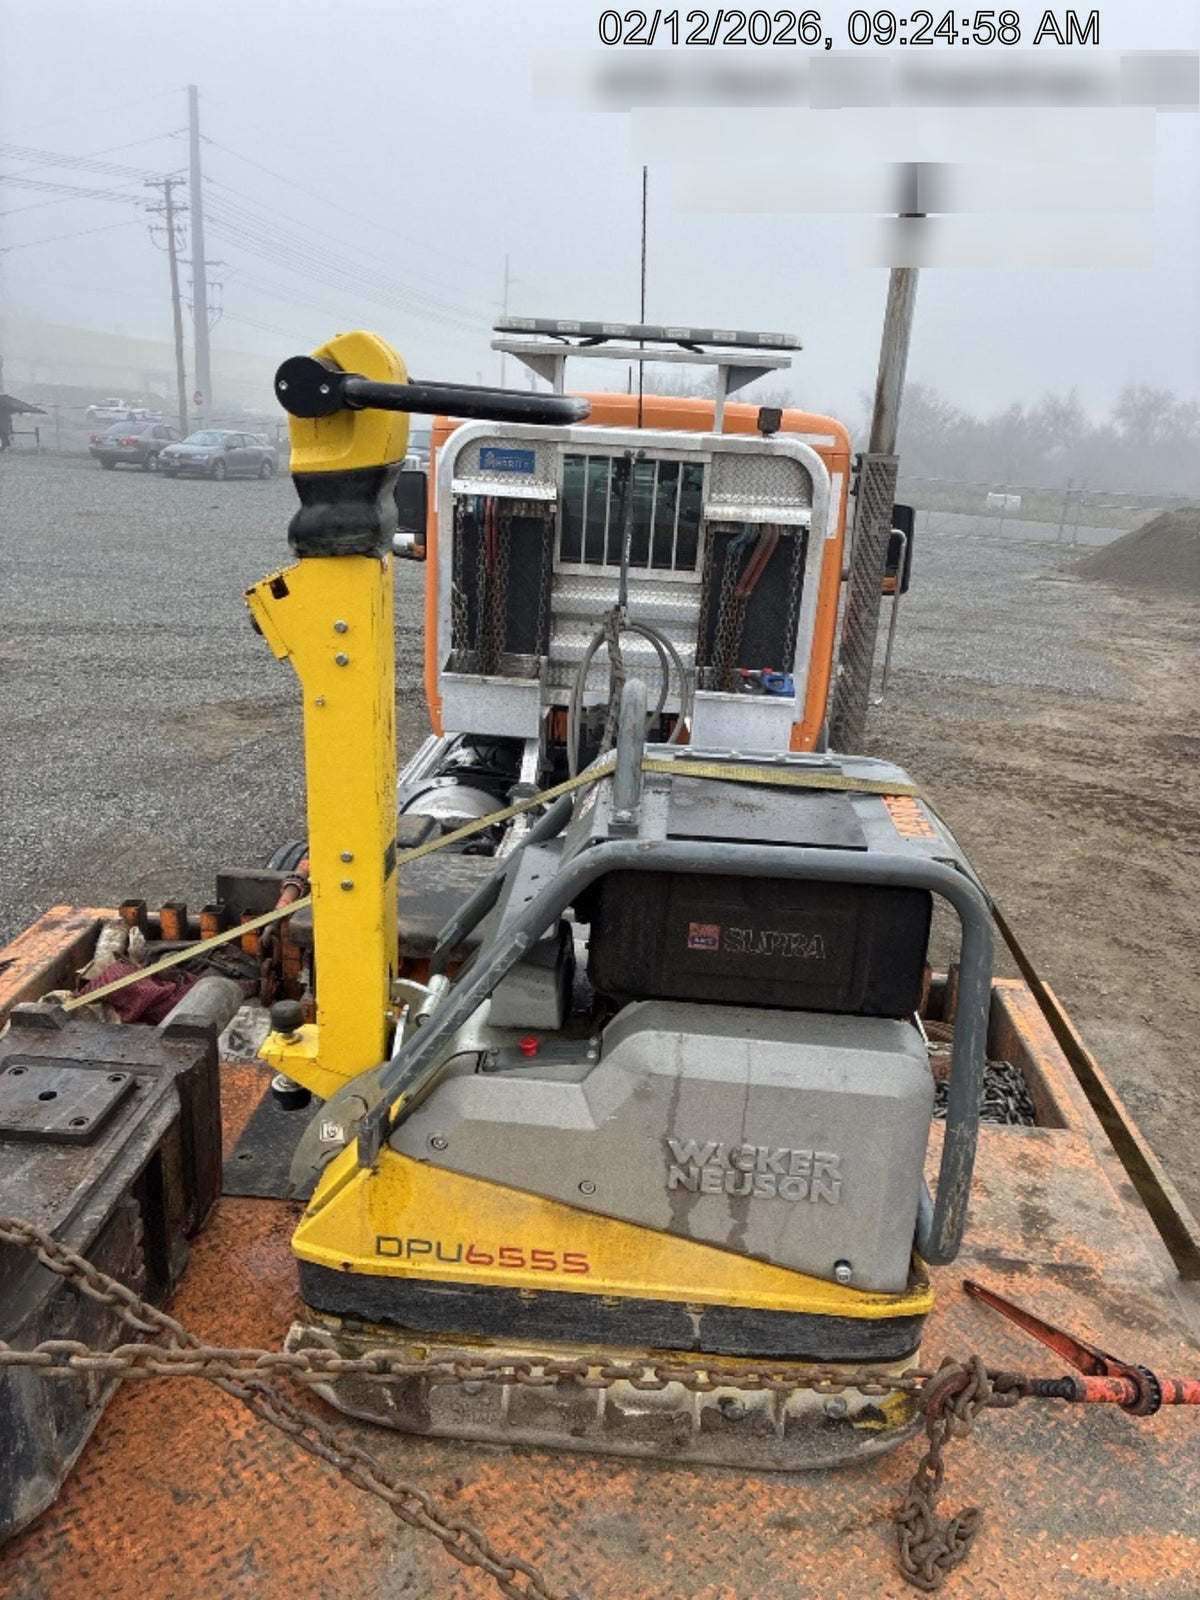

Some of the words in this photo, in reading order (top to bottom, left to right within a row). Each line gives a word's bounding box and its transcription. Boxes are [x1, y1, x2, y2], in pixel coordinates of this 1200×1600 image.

[724, 927, 826, 959] SUPRA
[667, 1139, 842, 1179] WACKER
[667, 1164, 842, 1205] NEUSON
[375, 1235, 590, 1274] DPU6555
